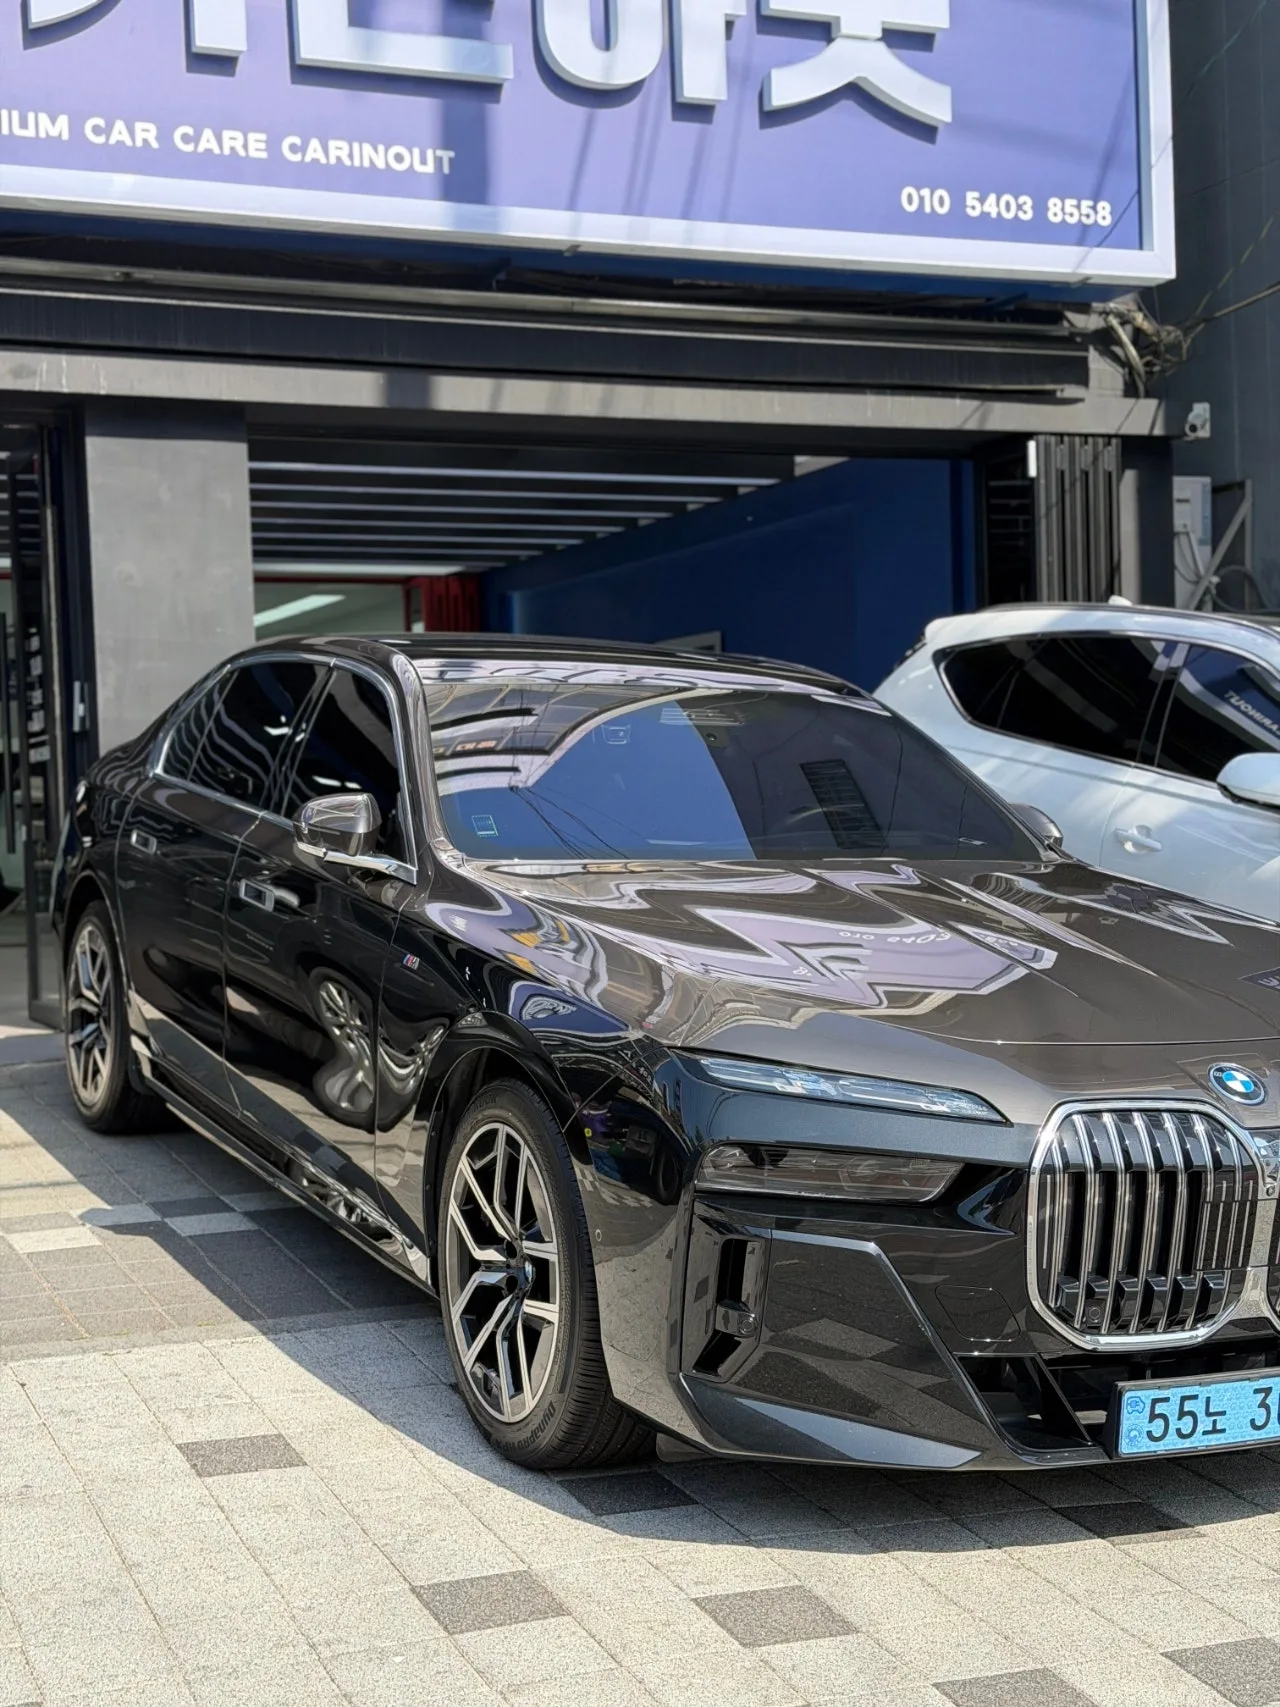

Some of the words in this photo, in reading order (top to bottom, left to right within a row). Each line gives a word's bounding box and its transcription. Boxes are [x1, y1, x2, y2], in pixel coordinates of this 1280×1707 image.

[0, 108, 70, 141] IUM
[84, 116, 160, 149] CAR
[173, 125, 269, 159] CARE
[281, 135, 455, 174] CARINOUT
[900, 186, 951, 214] 010
[965, 191, 1033, 221] 5403
[1047, 197, 1112, 227] 8558
[1146, 1393, 1227, 1443] 55노
[1250, 1386, 1280, 1432] 3
